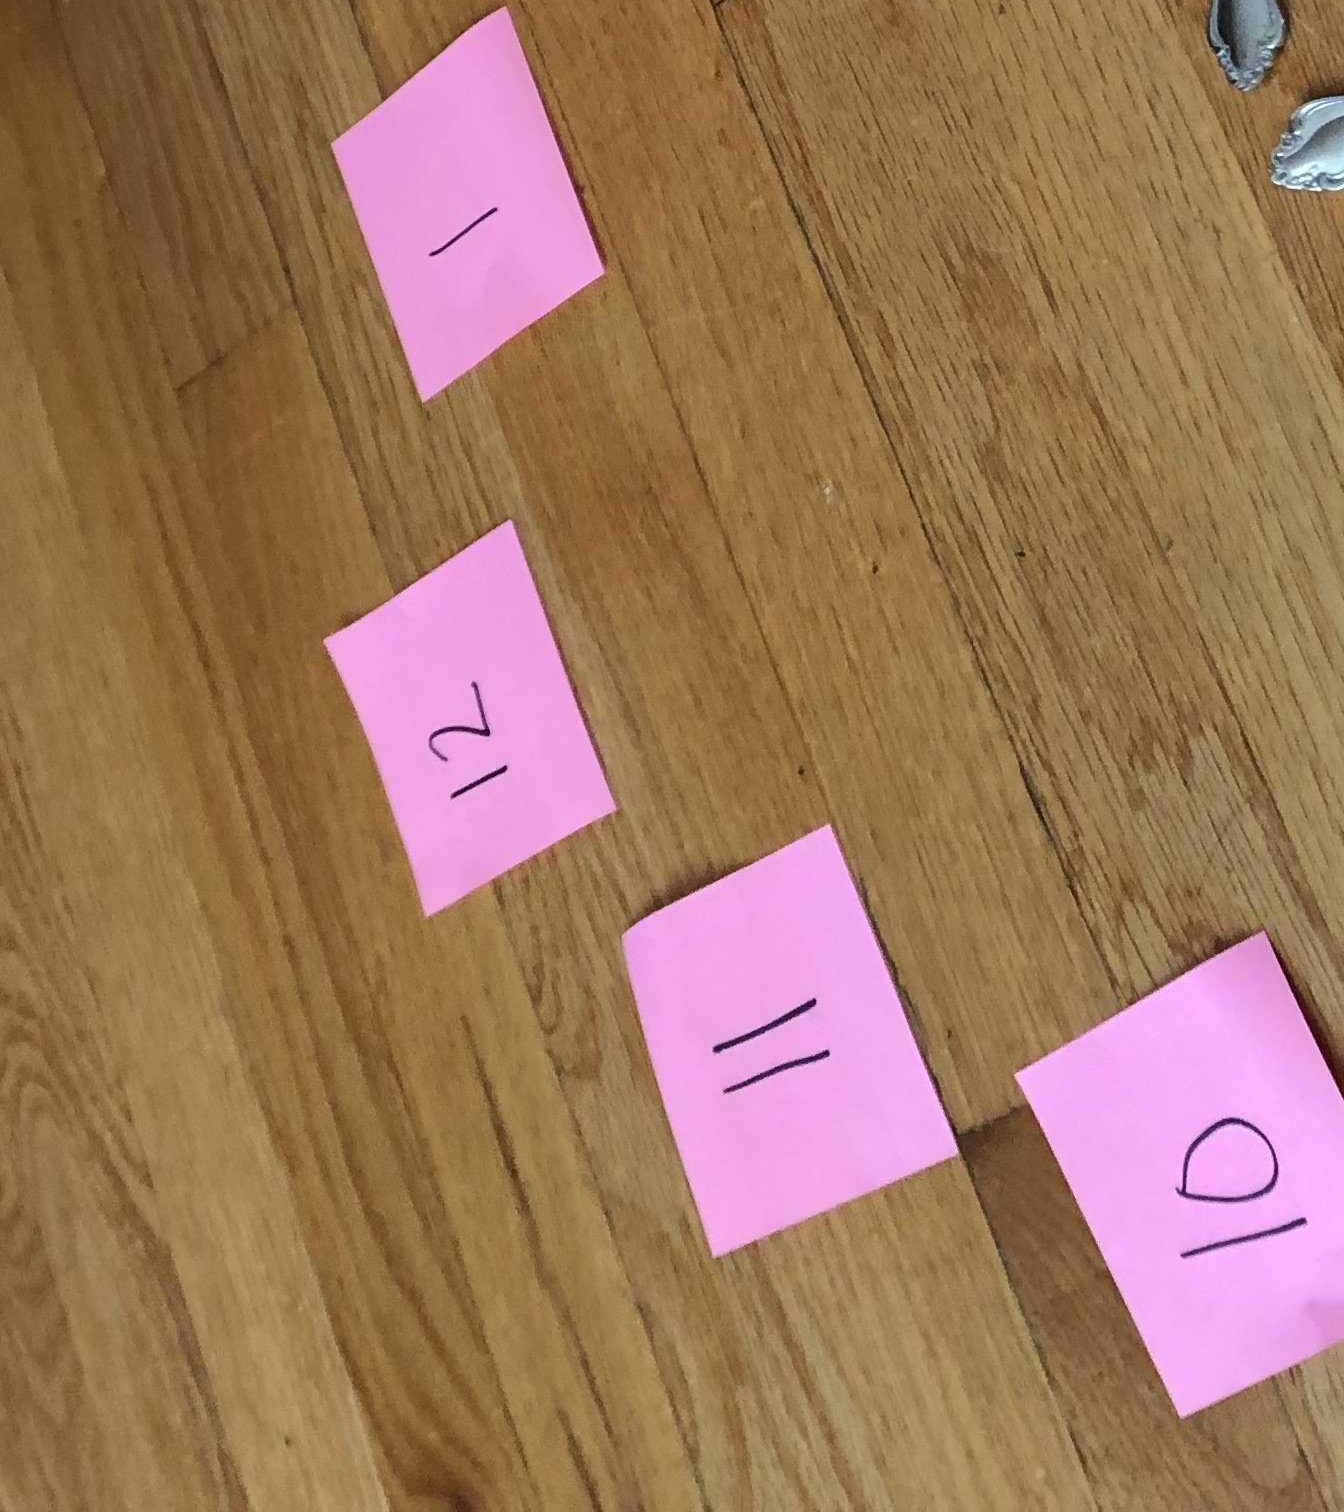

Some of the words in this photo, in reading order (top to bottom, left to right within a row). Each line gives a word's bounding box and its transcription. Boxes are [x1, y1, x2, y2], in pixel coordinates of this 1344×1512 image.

[429, 206, 498, 257] 1
[429, 681, 508, 800] 12
[712, 998, 830, 1094] 11
[1175, 1116, 1307, 1259] 10
